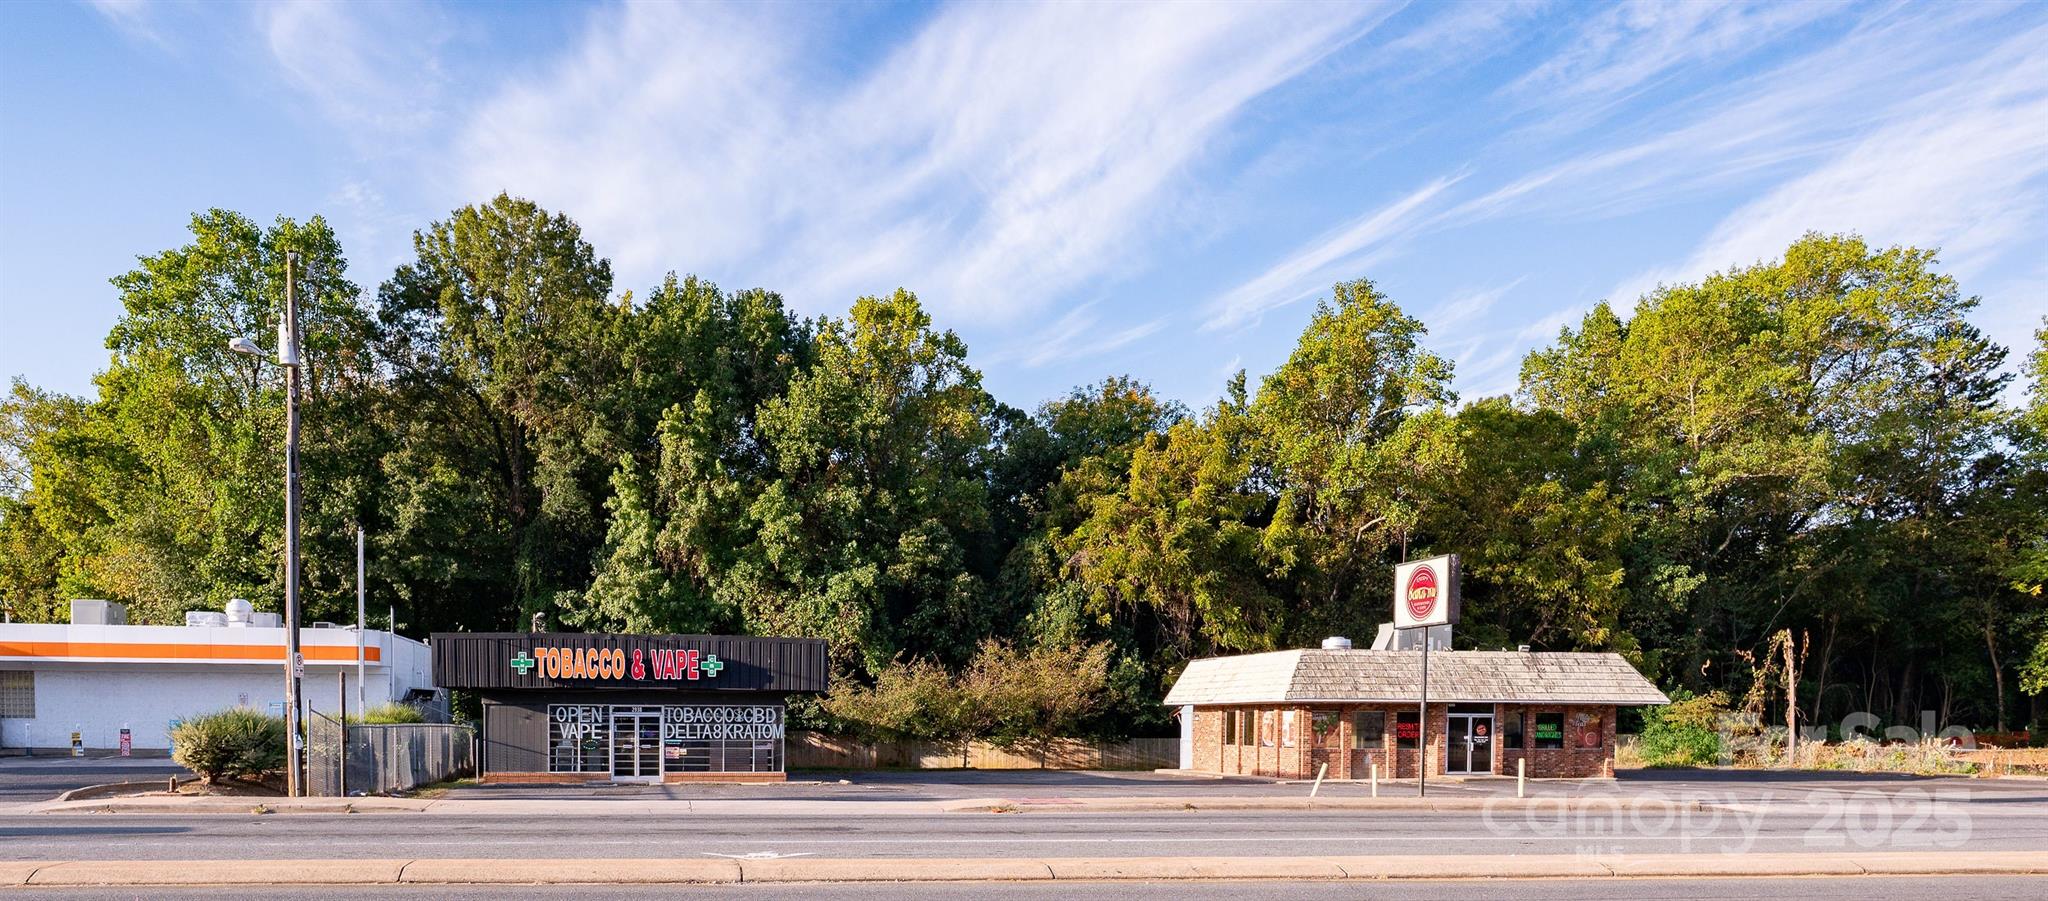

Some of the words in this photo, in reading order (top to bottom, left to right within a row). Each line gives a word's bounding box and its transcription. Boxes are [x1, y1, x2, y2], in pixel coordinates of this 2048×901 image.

[535, 647, 625, 679] TOBACCO
[631, 649, 645, 680] &
[651, 650, 699, 680] VAPE
[556, 707, 602, 722] OPEN
[664, 707, 734, 722] TOBACCO
[744, 708, 776, 723] CBD
[560, 723, 602, 739] VAPE
[724, 724, 783, 739] KRATOM
